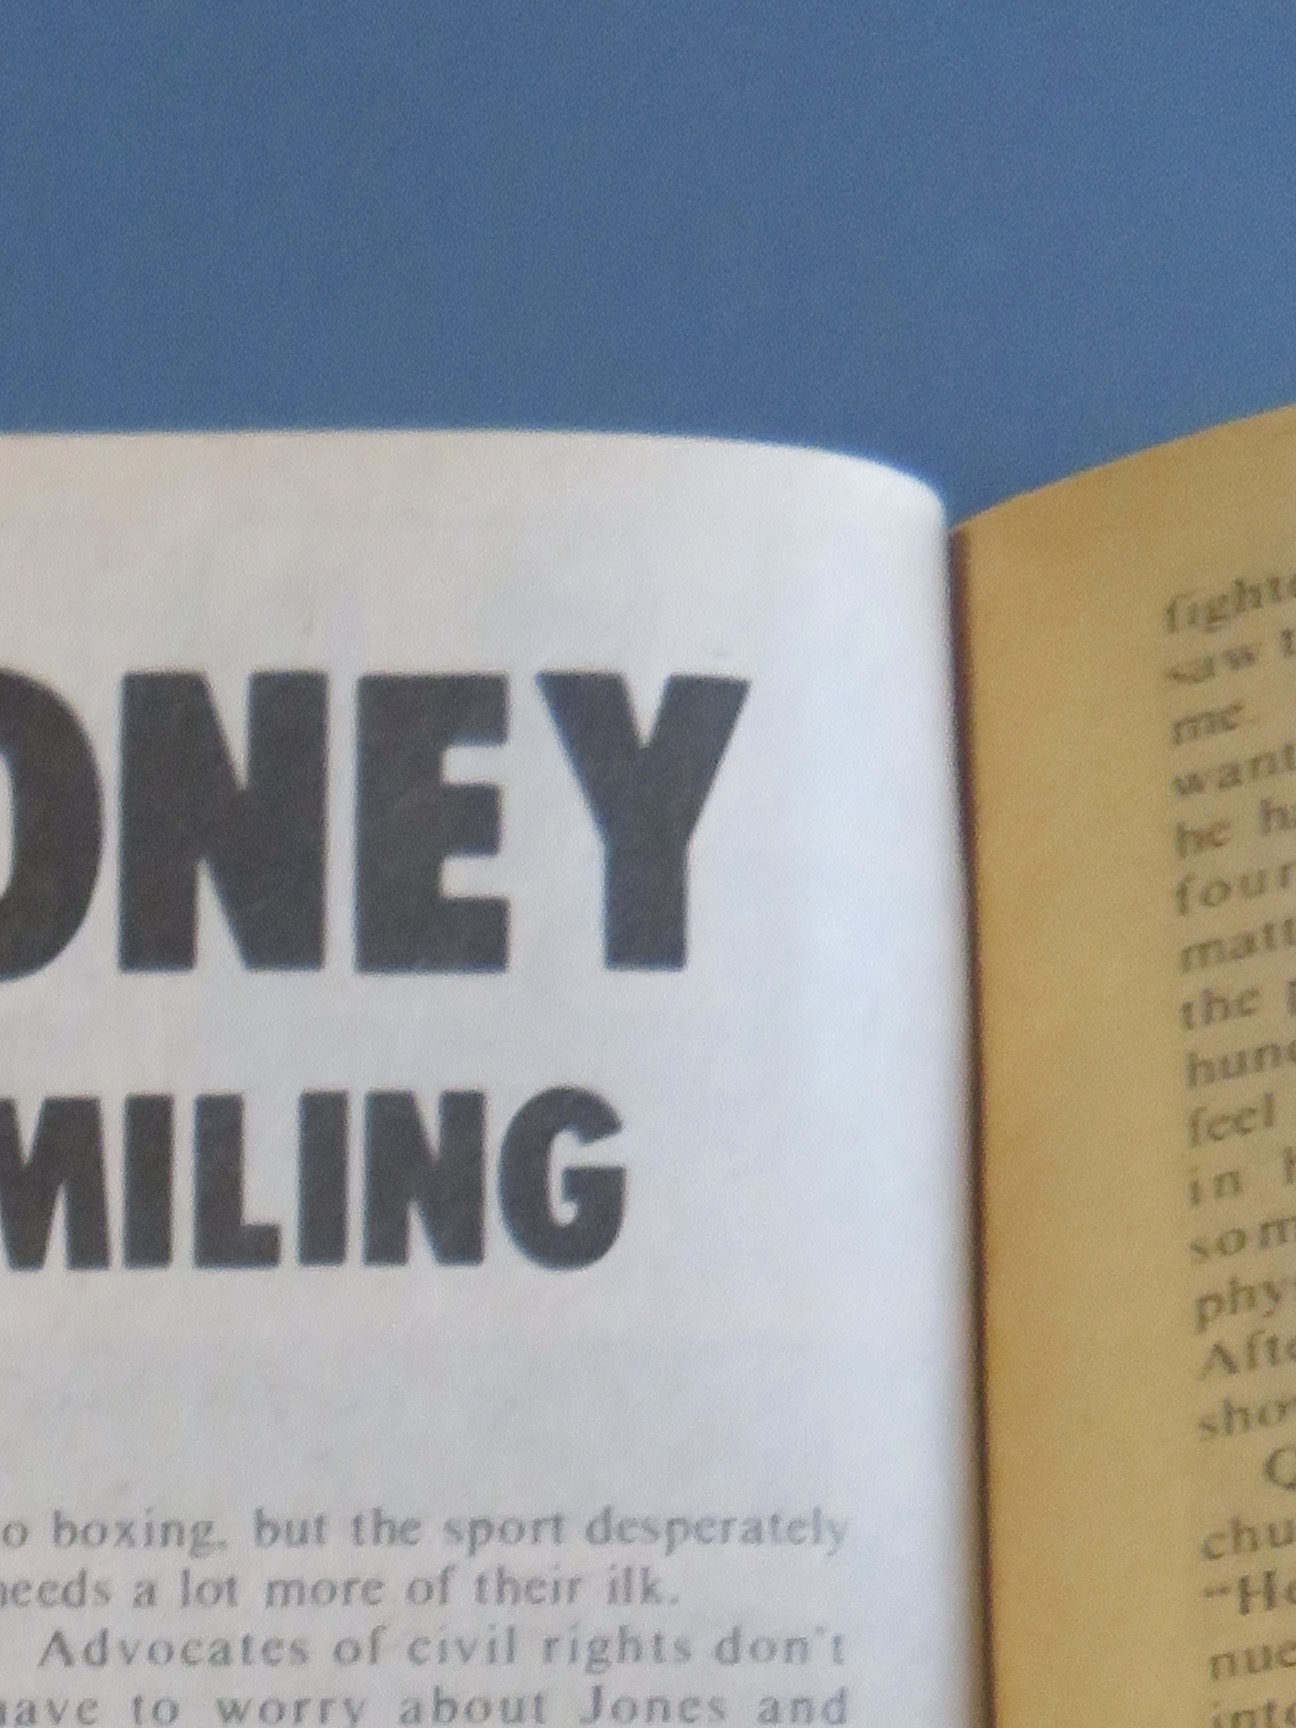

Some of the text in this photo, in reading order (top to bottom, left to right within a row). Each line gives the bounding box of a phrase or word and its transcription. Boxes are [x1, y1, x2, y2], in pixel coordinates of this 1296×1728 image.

[1164, 643, 1264, 686] saw
[1174, 820, 1232, 860] he
[1178, 988, 1260, 1031] the
[1188, 1092, 1276, 1148] feel
[1188, 1165, 1244, 1207] in
[1194, 1276, 1296, 1334] phy
[49, 1505, 230, 1562] boxing,
[251, 1504, 331, 1550] but
[347, 1504, 425, 1549] the
[440, 1509, 569, 1561] sport
[581, 1502, 848, 1559] desperately
